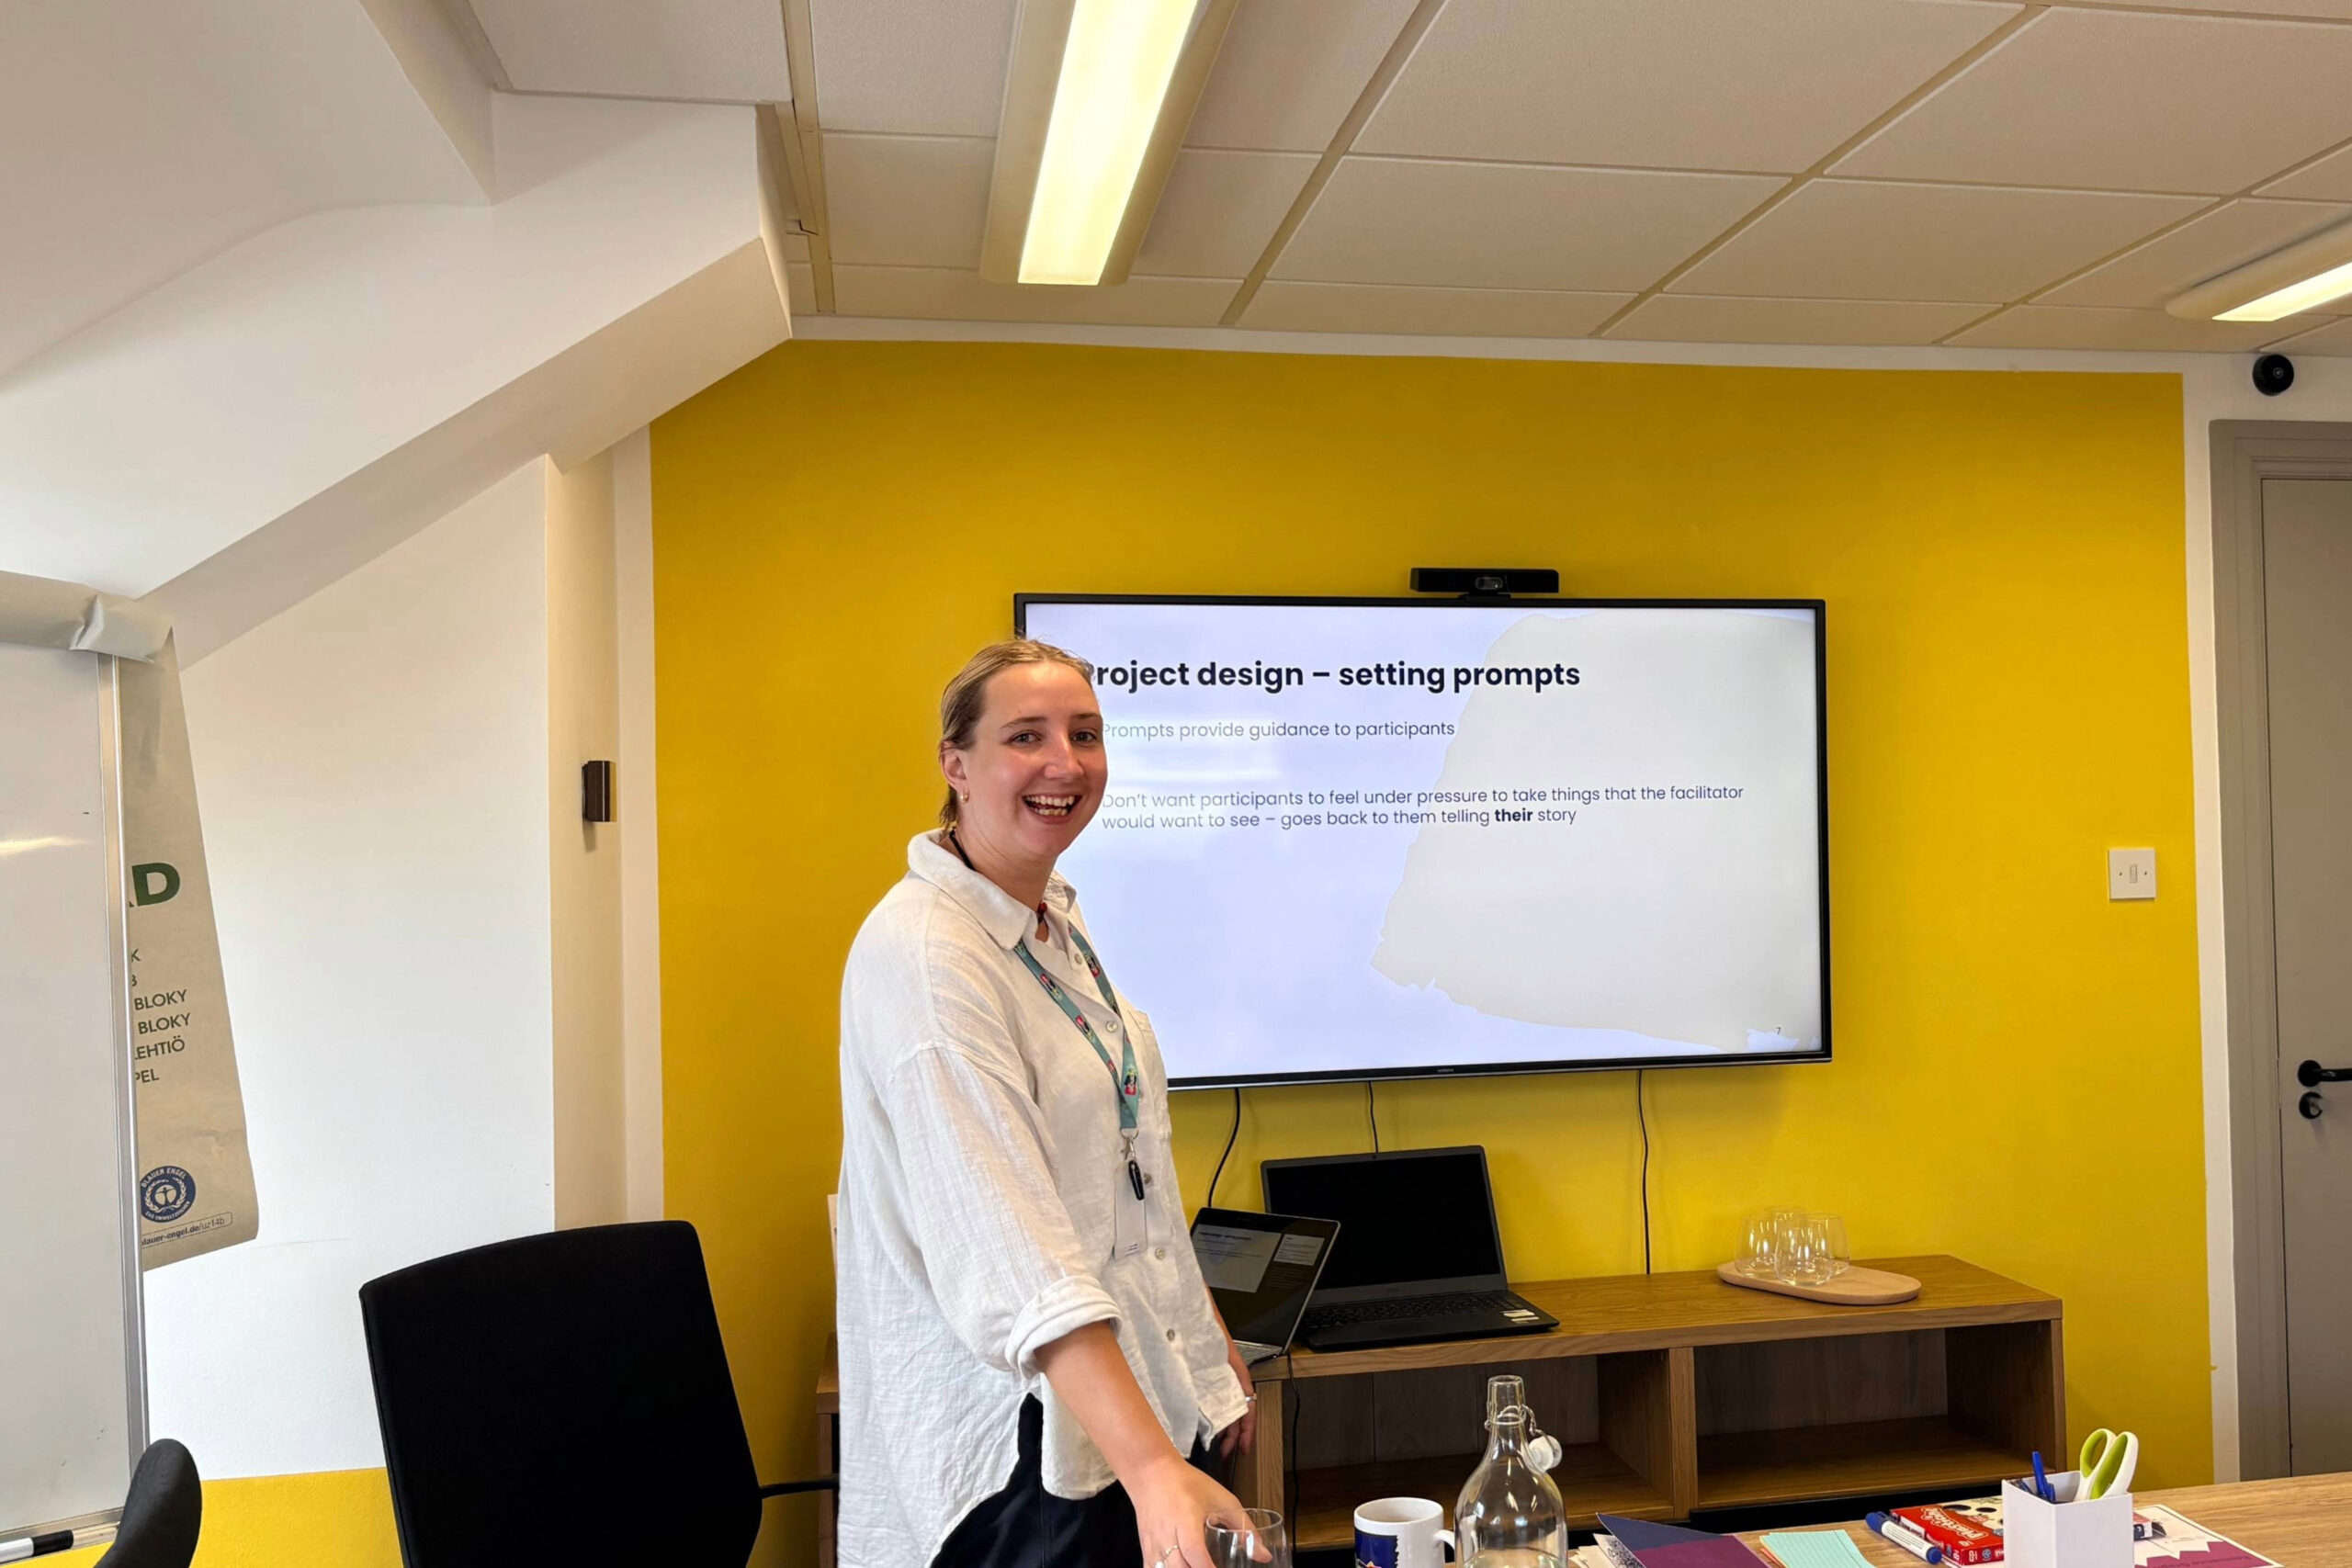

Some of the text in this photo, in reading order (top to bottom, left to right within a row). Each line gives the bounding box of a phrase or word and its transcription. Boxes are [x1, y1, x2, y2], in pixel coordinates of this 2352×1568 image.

[1093, 660, 1190, 694] roject
[1197, 660, 1304, 694] design
[1340, 660, 1445, 694] setting
[1453, 662, 1580, 694] prompts
[1180, 722, 1244, 742] provide
[1249, 722, 1330, 741] guidance
[1334, 723, 1351, 736] to
[1355, 720, 1455, 740] participants
[1151, 794, 1196, 807] want
[1201, 791, 1304, 810] participants
[1308, 792, 1326, 806] to
[1329, 790, 1360, 805] feel
[1364, 790, 1413, 805] under
[1418, 791, 1487, 807] pressure
[1492, 789, 1509, 803] to
[1512, 788, 1548, 803] take
[1552, 787, 1600, 806] things
[1604, 786, 1637, 801] that
[1640, 785, 1667, 800] the
[1670, 784, 1745, 800] facilitator
[1102, 814, 1155, 829] would
[1159, 813, 1204, 829] want
[1208, 813, 1226, 828] to
[1229, 814, 1261, 827] see
[1281, 814, 1322, 830] goes
[1327, 810, 1368, 825] back
[1372, 811, 1389, 825] to
[1393, 809, 1437, 824] them
[1441, 808, 1490, 828] telling
[1494, 807, 1533, 823] their
[1537, 808, 1577, 826] story
[133, 988, 187, 1011] BLOKY
[138, 1012, 191, 1035] BLOKY
[1776, 1026, 1781, 1035] 7
[134, 1034, 186, 1060] EHTIÖ
[165, 1167, 188, 1180] ENGEL
